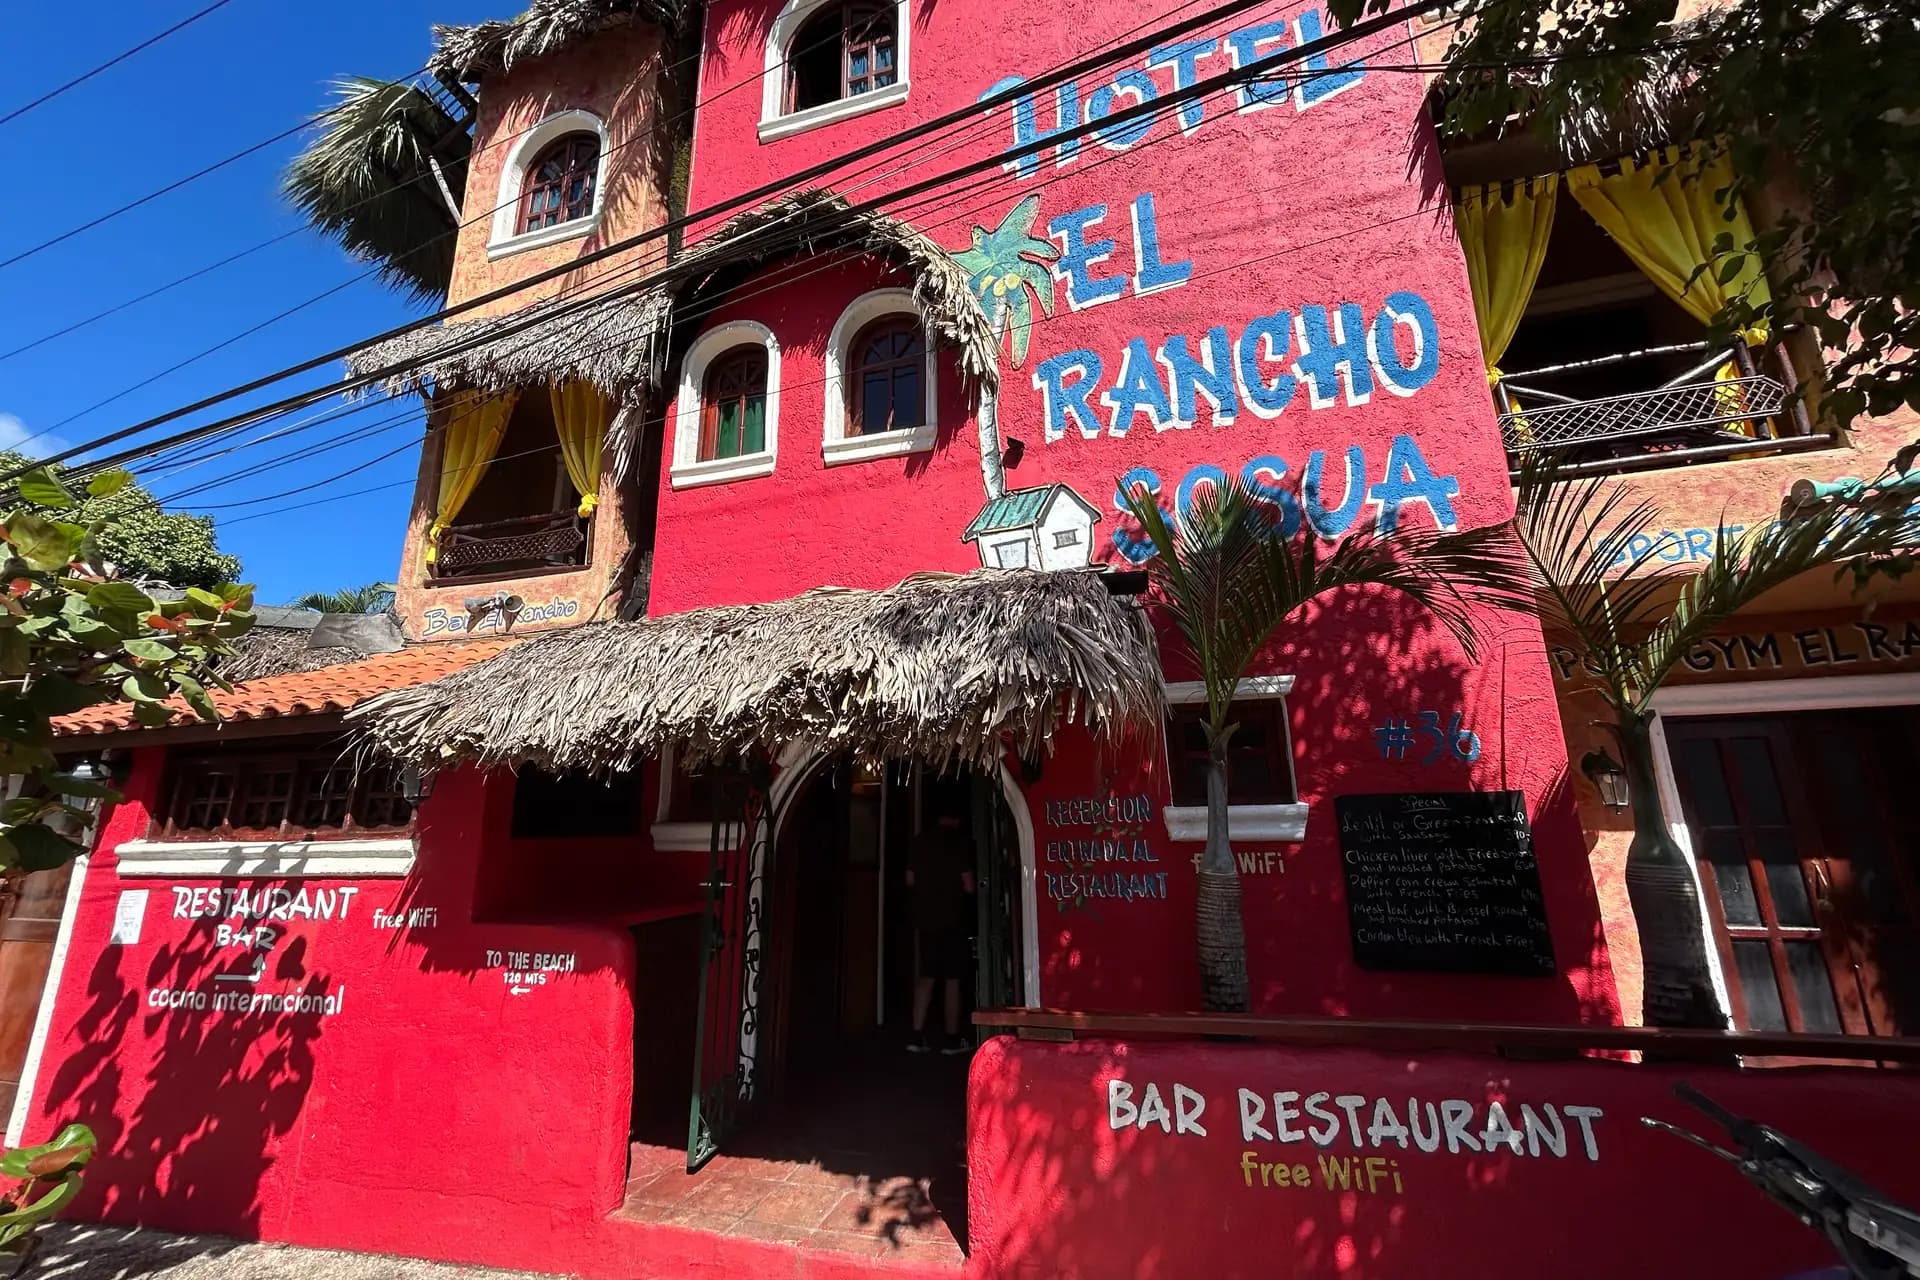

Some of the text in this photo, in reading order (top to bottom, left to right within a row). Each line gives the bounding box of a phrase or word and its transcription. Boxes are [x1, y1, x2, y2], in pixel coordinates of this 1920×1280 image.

[977, 8, 1365, 181] HOTEL
[1048, 192, 1194, 312] EL
[1032, 291, 1440, 444] RANCHO
[1111, 433, 1460, 565] SOSUA
[515, 596, 578, 624] ancho
[1683, 631, 1783, 672] GYM
[1791, 626, 1857, 668] EL
[1373, 709, 1483, 764] #36
[1045, 794, 1151, 828] RECEPCION
[1046, 839, 1160, 863] ENTRADA AL
[1237, 851, 1286, 875] WiFi
[1044, 869, 1168, 902] RESTAURANT
[171, 886, 358, 921] RESTAURANT
[373, 907, 437, 930] free WiFi
[1447, 903, 1489, 916] Bssel
[215, 925, 276, 951] BAR
[486, 950, 575, 973] TO THE BEACH
[503, 972, 546, 985] 120 MTS
[212, 985, 344, 1015] internacional
[1107, 1079, 1604, 1162] BAR RESTAURANT
[1240, 1151, 1404, 1194] free WiFi
